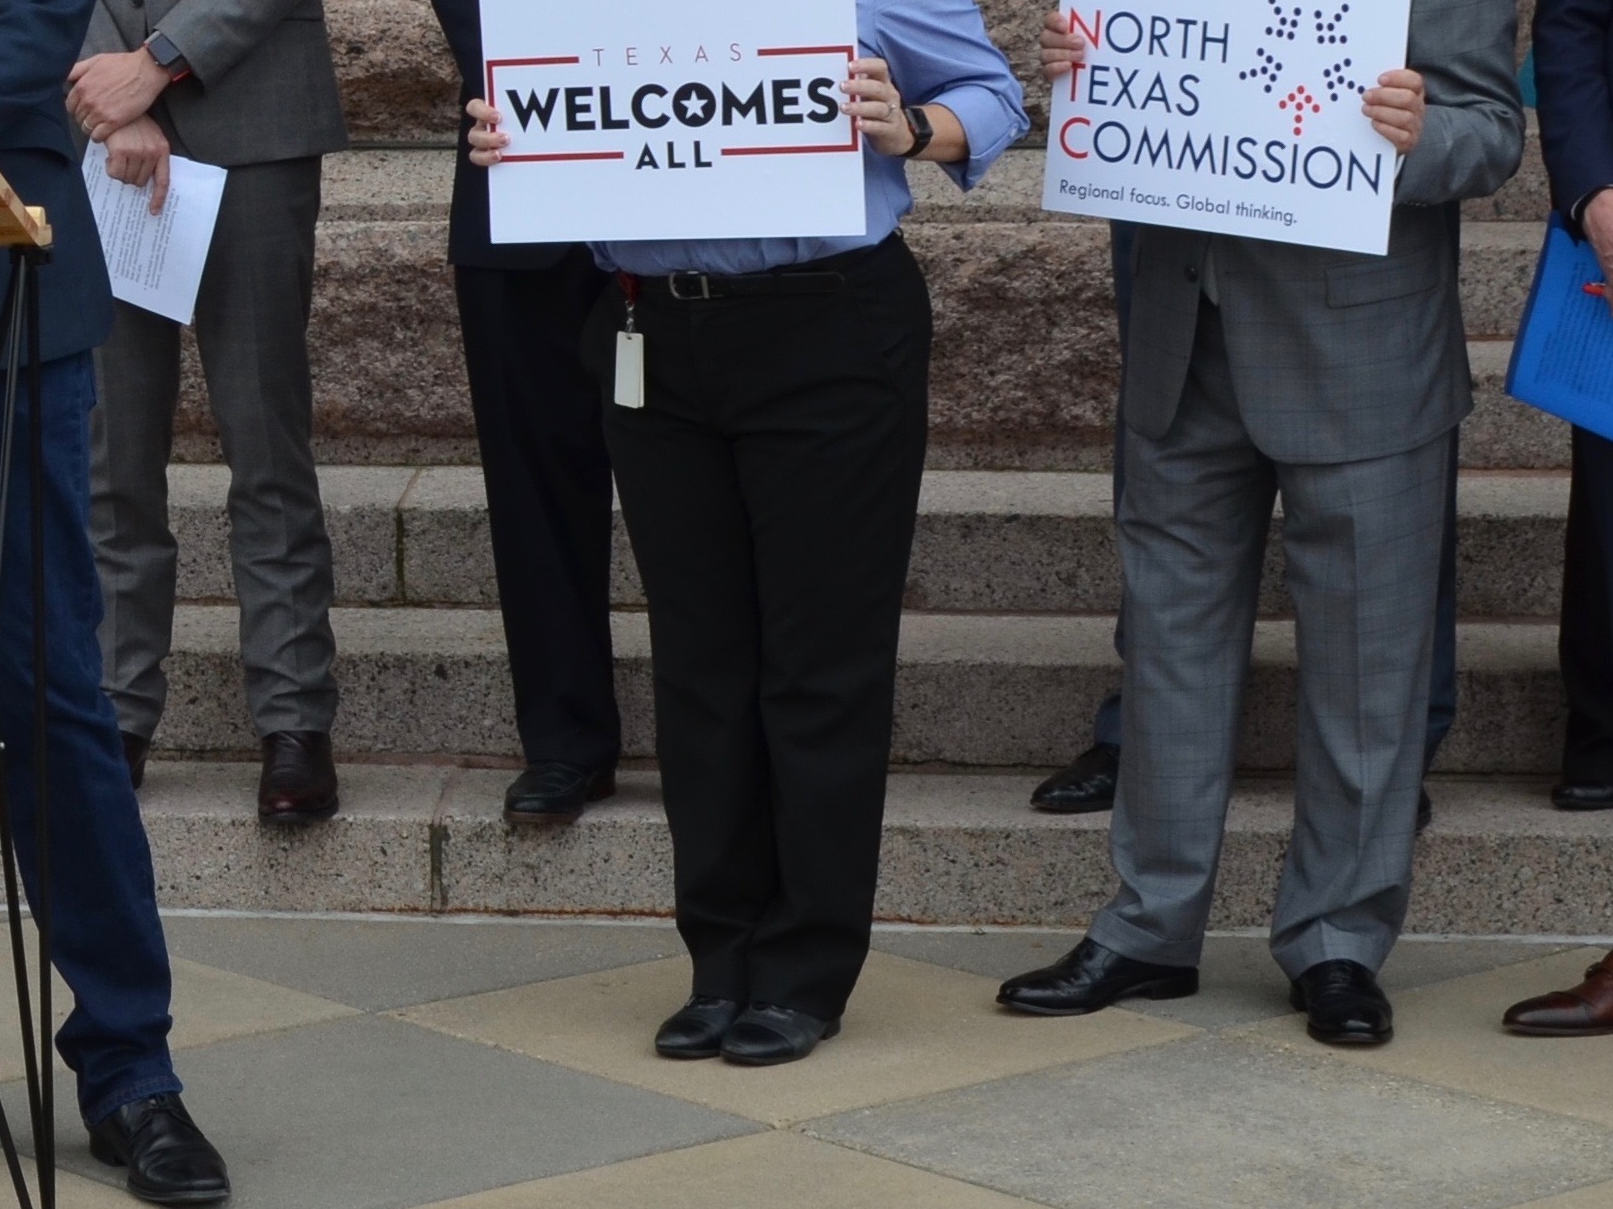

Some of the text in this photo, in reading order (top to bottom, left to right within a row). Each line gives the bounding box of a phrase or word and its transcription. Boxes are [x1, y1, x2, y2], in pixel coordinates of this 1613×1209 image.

[592, 43, 742, 67] TEXAS
[1069, 6, 1229, 64] NORTH
[505, 77, 839, 132] WELCOMES
[1069, 61, 1201, 117] TEXAS
[634, 140, 713, 170] ALL
[1059, 116, 1382, 196] COMMISSION
[1059, 178, 1298, 227] Regional focus. Global thinking.
